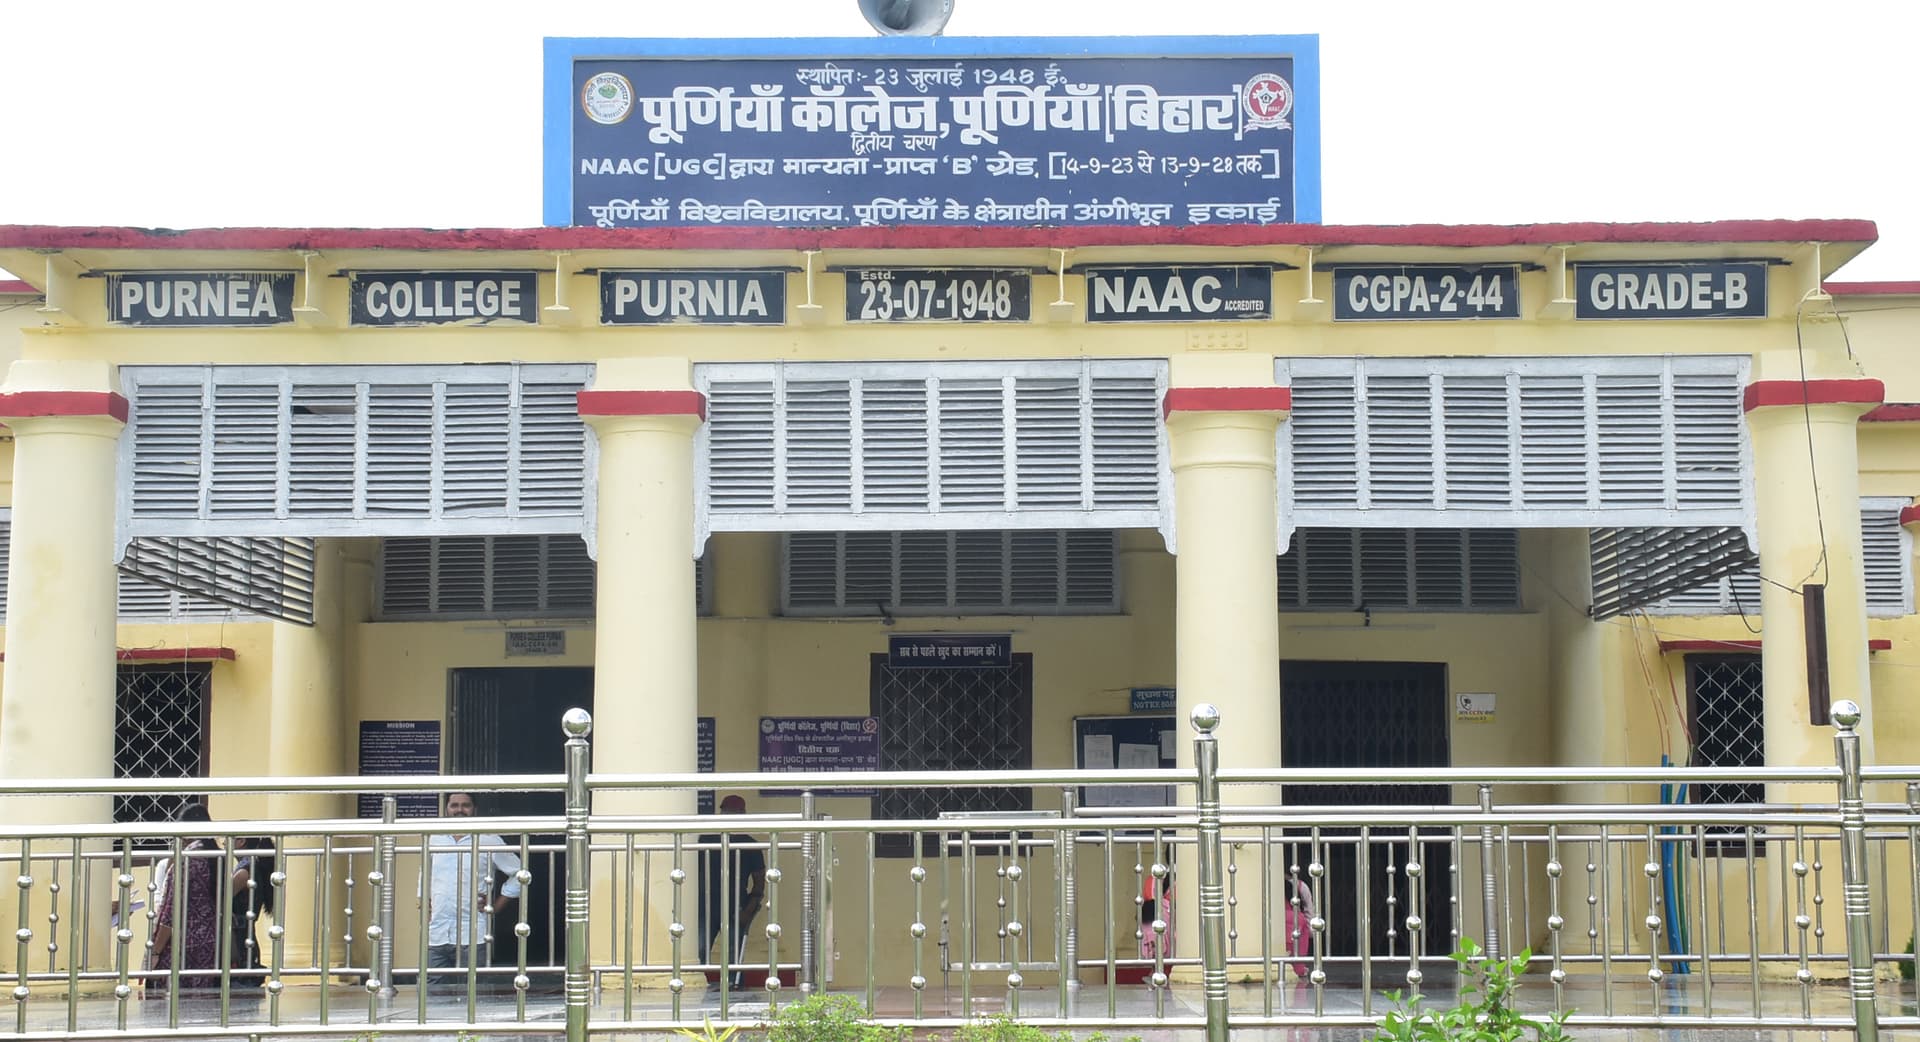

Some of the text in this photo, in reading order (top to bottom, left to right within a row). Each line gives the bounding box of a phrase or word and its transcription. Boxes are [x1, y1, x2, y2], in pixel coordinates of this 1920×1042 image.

[874, 68, 899, 85] 23
[905, 62, 965, 93] जुलाई
[974, 68, 1034, 85] 1948
[640, 84, 784, 144] पूर्णियाँ
[850, 133, 938, 156] द्वितीय चरण
[581, 157, 649, 175] NAAC
[729, 158, 774, 180] द्वारा
[1137, 151, 1155, 174] से
[1161, 157, 1233, 174] 13-9-28
[588, 197, 669, 226] पूर्णियाँ
[852, 197, 938, 226] पूर्णियाँ
[943, 198, 970, 220] के
[974, 197, 1068, 222] क्षेत्राधीन
[1074, 197, 1173, 226] अंगीभूत
[1187, 197, 1281, 224] इकाई
[860, 271, 896, 281] Estd.
[1590, 272, 1748, 311] GRADE-B
[121, 278, 768, 319] PURNEA COLLEGE PURNIA
[861, 280, 1012, 319] 23-07-1948
[1094, 275, 1265, 314] NAAC ACCREDITED
